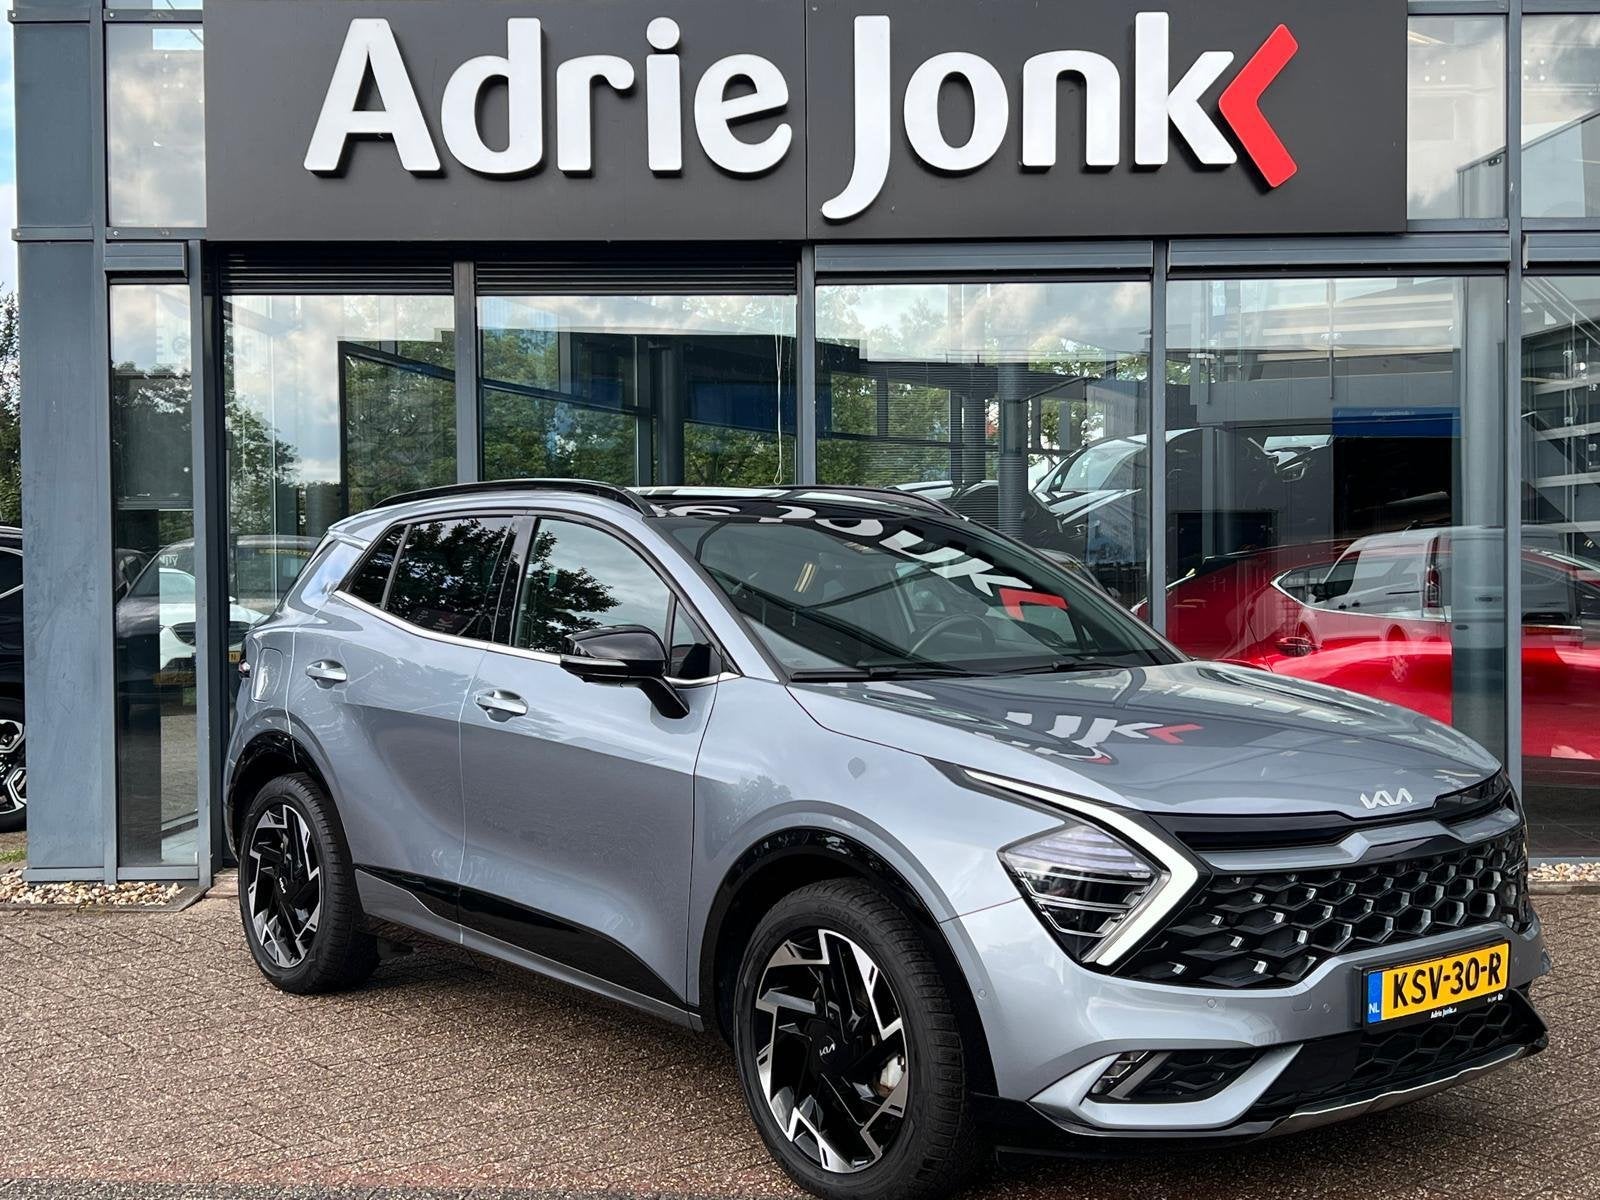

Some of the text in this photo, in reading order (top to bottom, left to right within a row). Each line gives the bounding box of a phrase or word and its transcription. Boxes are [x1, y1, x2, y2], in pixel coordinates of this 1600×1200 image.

[303, 11, 1239, 220] Adrie Jonk
[1359, 787, 1414, 810] KIA
[1392, 952, 1502, 1010] KSV-30-R
[1367, 1001, 1380, 1014] NL
